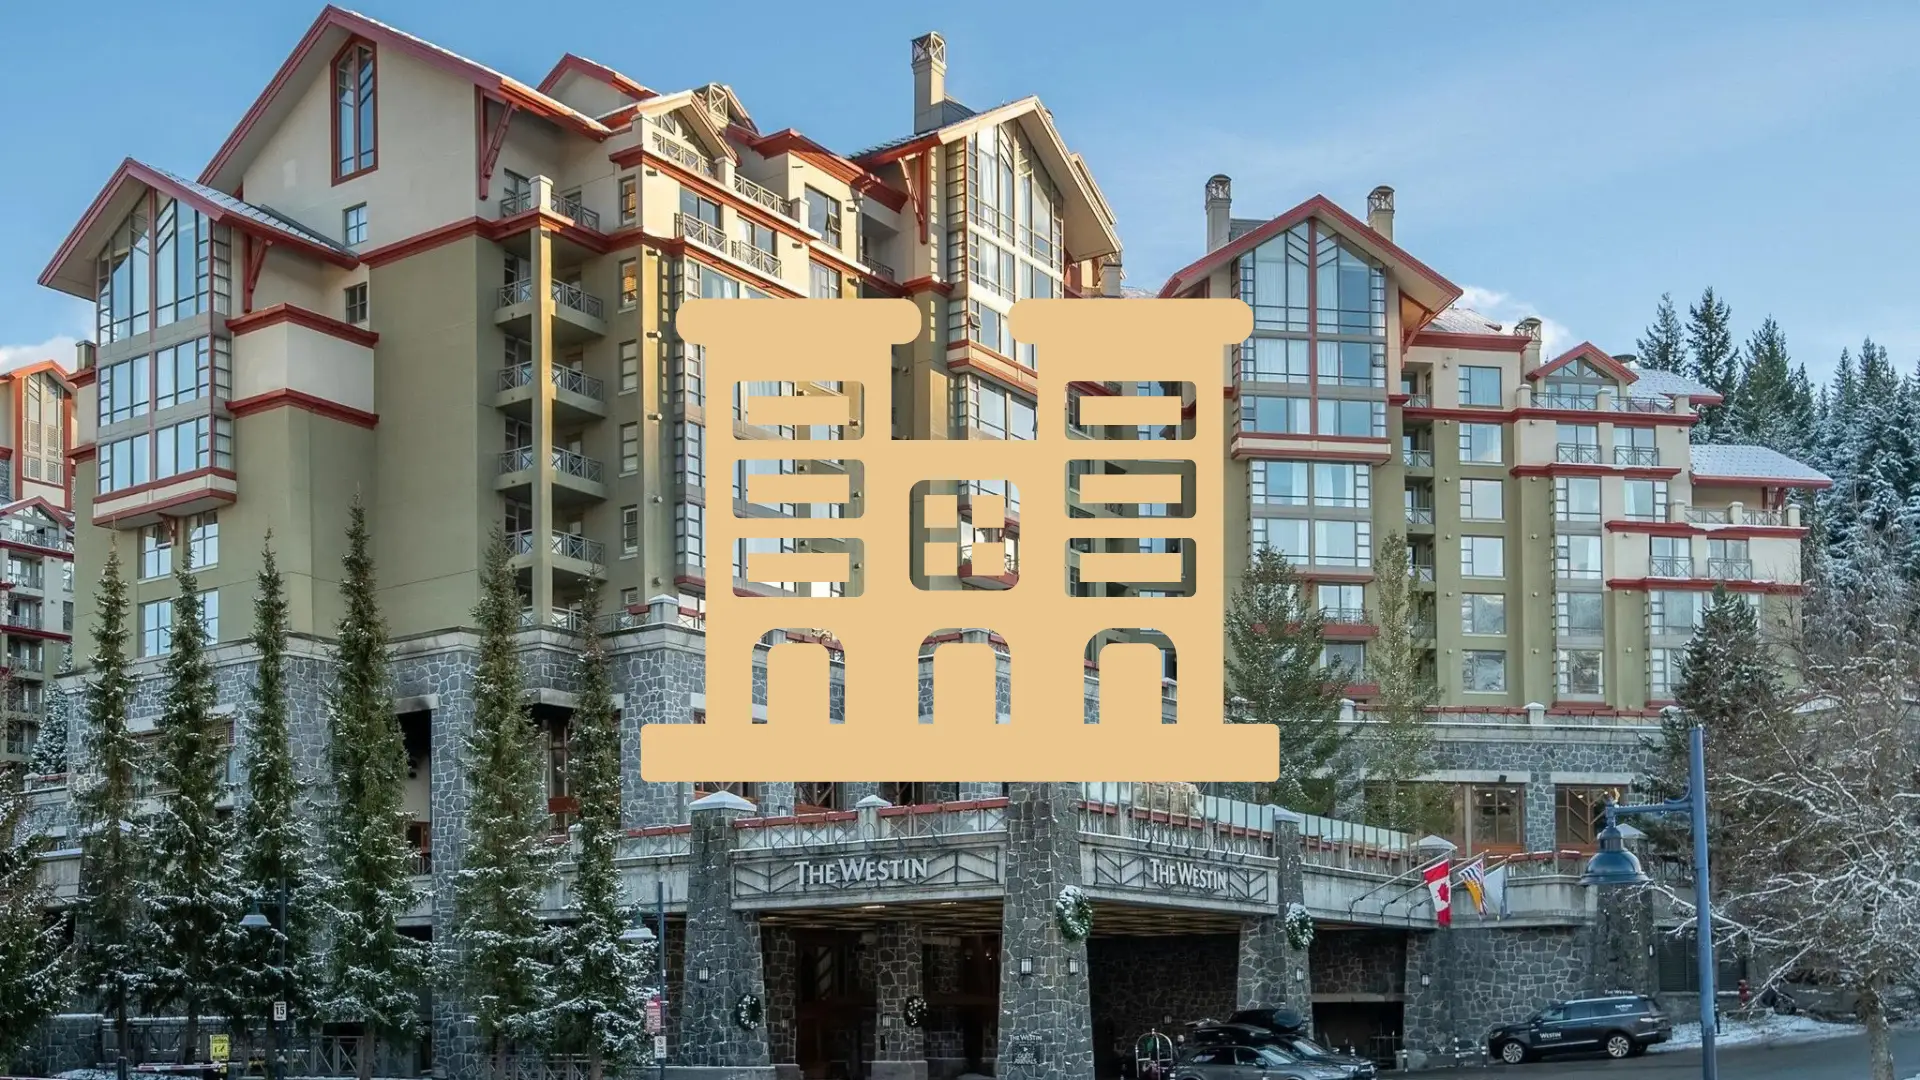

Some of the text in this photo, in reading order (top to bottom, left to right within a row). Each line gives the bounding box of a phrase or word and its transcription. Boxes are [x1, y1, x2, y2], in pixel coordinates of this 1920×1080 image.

[794, 857, 928, 885] THE WESTIN
[1149, 858, 1227, 890] THE WESTIN
[276, 1006, 285, 1015] 15
[1539, 1031, 1562, 1039] WESTIN
